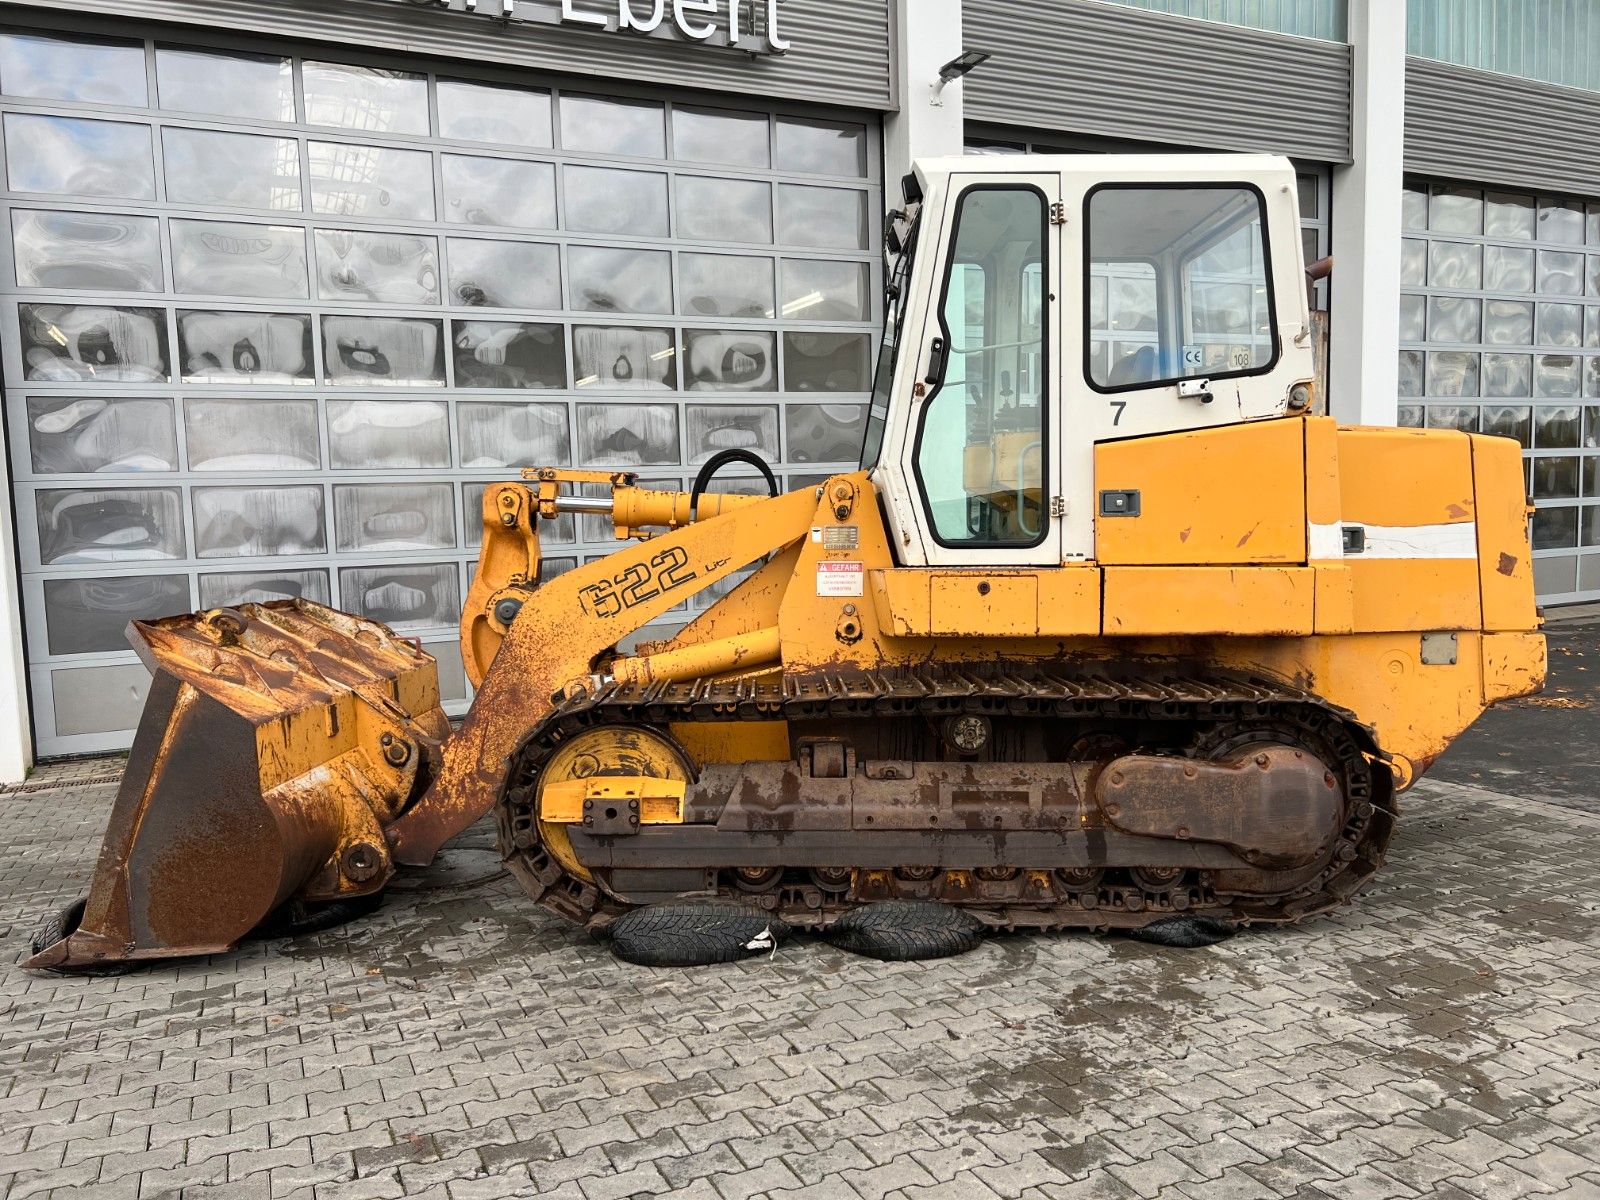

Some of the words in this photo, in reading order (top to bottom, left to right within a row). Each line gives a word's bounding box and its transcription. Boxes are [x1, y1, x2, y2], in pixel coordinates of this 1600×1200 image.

[1185, 351, 1201, 363] CE
[1234, 353, 1249, 366] 108
[1110, 401, 1127, 426] 7
[831, 563, 859, 572] GEFAHR
[578, 546, 697, 618] 622
